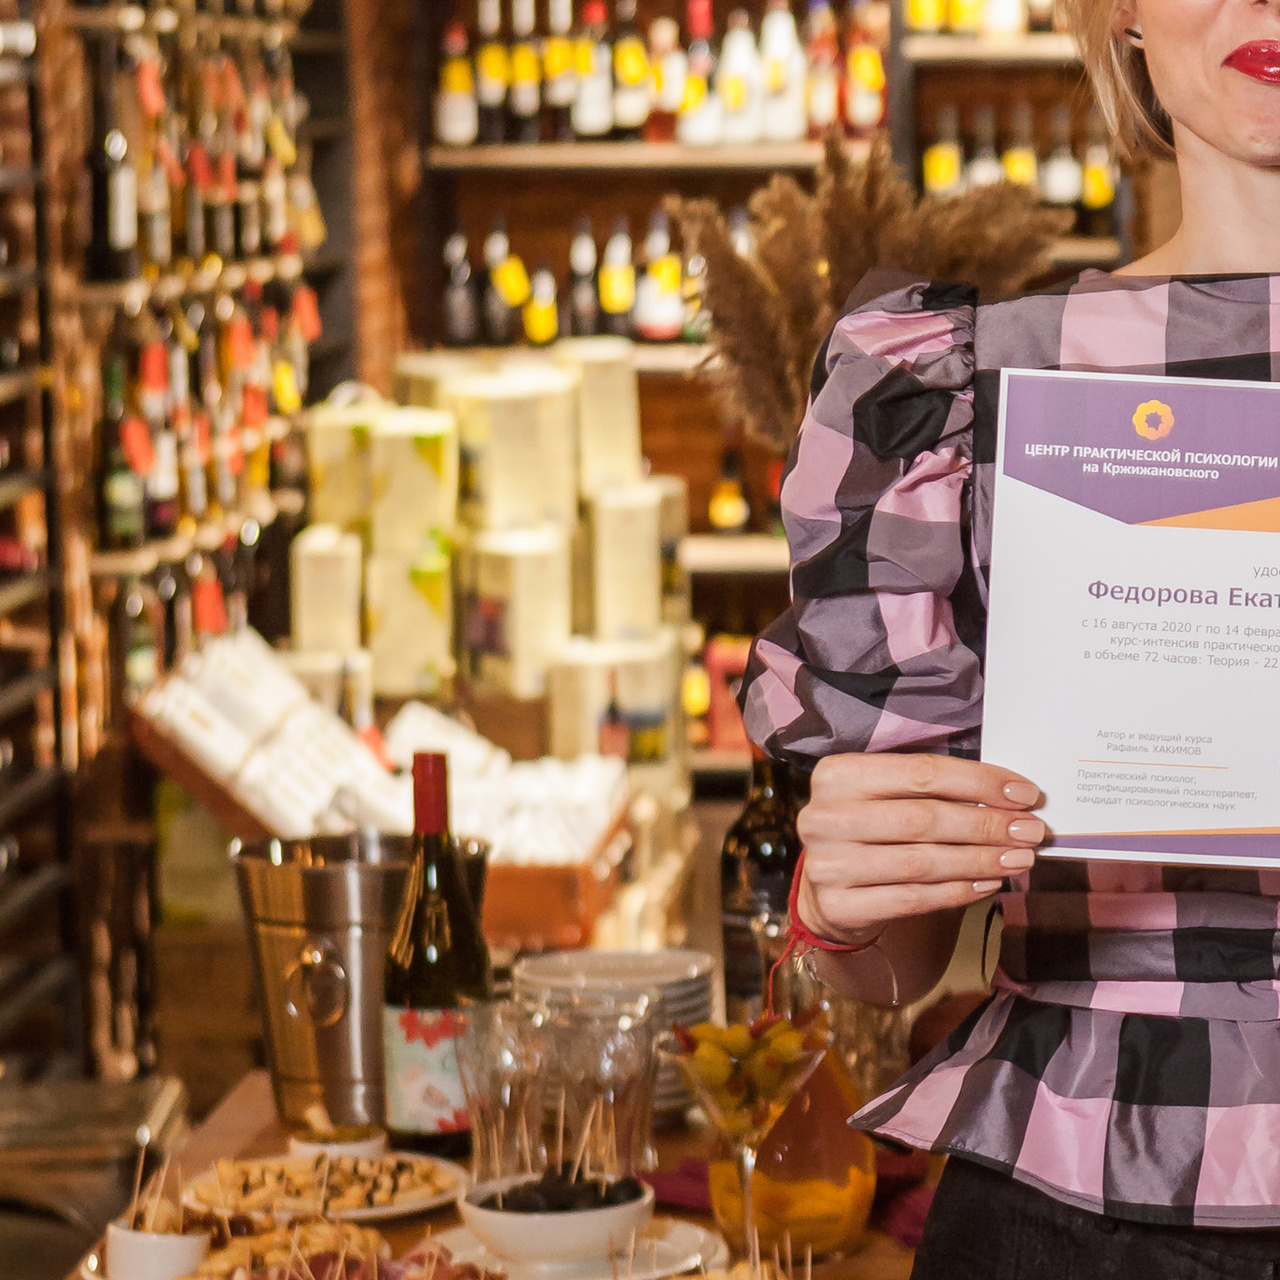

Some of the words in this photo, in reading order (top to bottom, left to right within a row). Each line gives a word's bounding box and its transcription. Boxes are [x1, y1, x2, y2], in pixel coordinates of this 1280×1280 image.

[1024, 443, 1070, 457] ЦЕНТР
[1073, 446, 1181, 463] ПРАКТИЧЕСКОЙ
[1185, 452, 1279, 468] ПСИХОЛОГИИ
[1082, 462, 1099, 473] на
[1103, 462, 1220, 480] Кржижановского
[1087, 580, 1219, 608] Федорова
[1081, 619, 1089, 628] с
[1092, 618, 1108, 629] 16
[1111, 620, 1158, 632] августа
[1161, 621, 1192, 633] 2020
[1195, 624, 1202, 633] г
[1205, 625, 1221, 635] по
[1225, 625, 1240, 635] 14
[1110, 635, 1200, 650] курс-интенсив
[1083, 650, 1091, 659] в
[1095, 649, 1140, 662] объеме
[1144, 651, 1159, 663] 72
[1163, 654, 1202, 665] часов:
[1207, 654, 1250, 668] Теория
[1263, 657, 1278, 669] 22
[1096, 729, 1126, 741] Автор
[1138, 732, 1182, 743] ведущий
[1185, 735, 1213, 745] курса
[1106, 742, 1150, 754] Рафаиль
[1152, 744, 1202, 756] ХАКИМОВ
[1077, 769, 1148, 781] Практический
[1150, 773, 1198, 786] психолог,
[1076, 782, 1180, 796] сертифицированный
[1076, 795, 1123, 806] кандидат
[1125, 797, 1210, 810] психологических
[1212, 802, 1237, 812] наук
